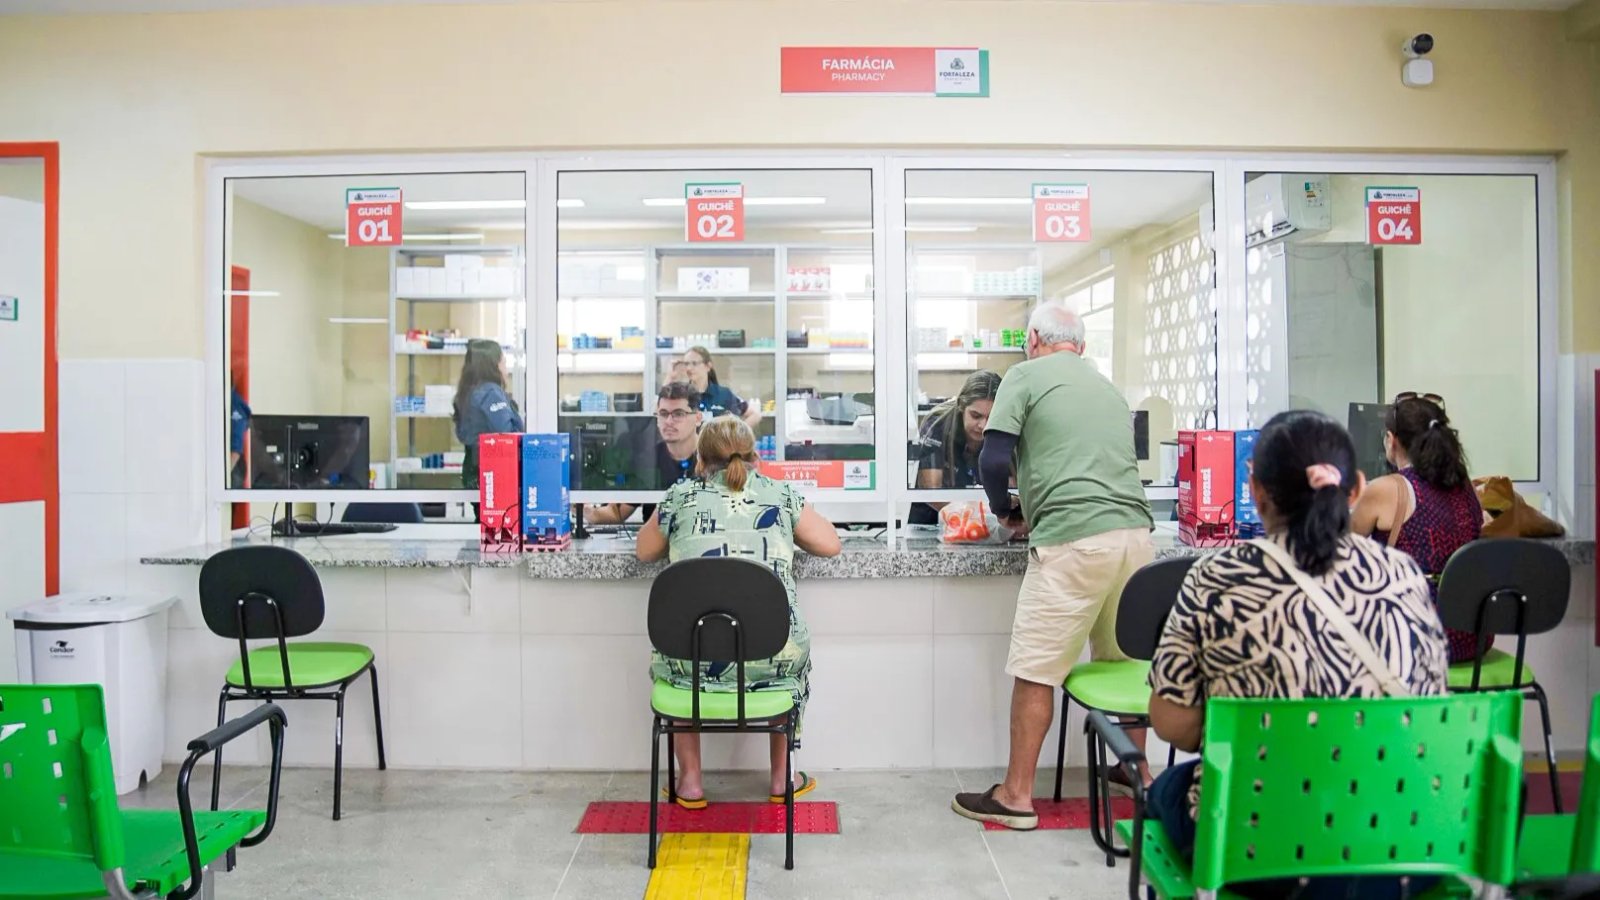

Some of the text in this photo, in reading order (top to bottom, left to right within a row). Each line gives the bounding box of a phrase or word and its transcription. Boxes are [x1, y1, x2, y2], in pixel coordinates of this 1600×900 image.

[822, 56, 895, 70] FARMÁCIA
[831, 72, 885, 81] PHARMACY
[357, 204, 393, 217] GUICHÊ
[698, 199, 735, 212] GUICHÊ
[1045, 200, 1081, 212] GUICHÊ
[1377, 203, 1412, 215] GUICHÊ
[358, 220, 393, 242] 01
[697, 214, 736, 238] 02
[1045, 215, 1081, 238] 03
[1377, 218, 1414, 240] 04
[483, 471, 494, 509] sensi
[527, 486, 538, 509] tex
[1200, 468, 1212, 505] sensi
[1239, 482, 1250, 505] tex
